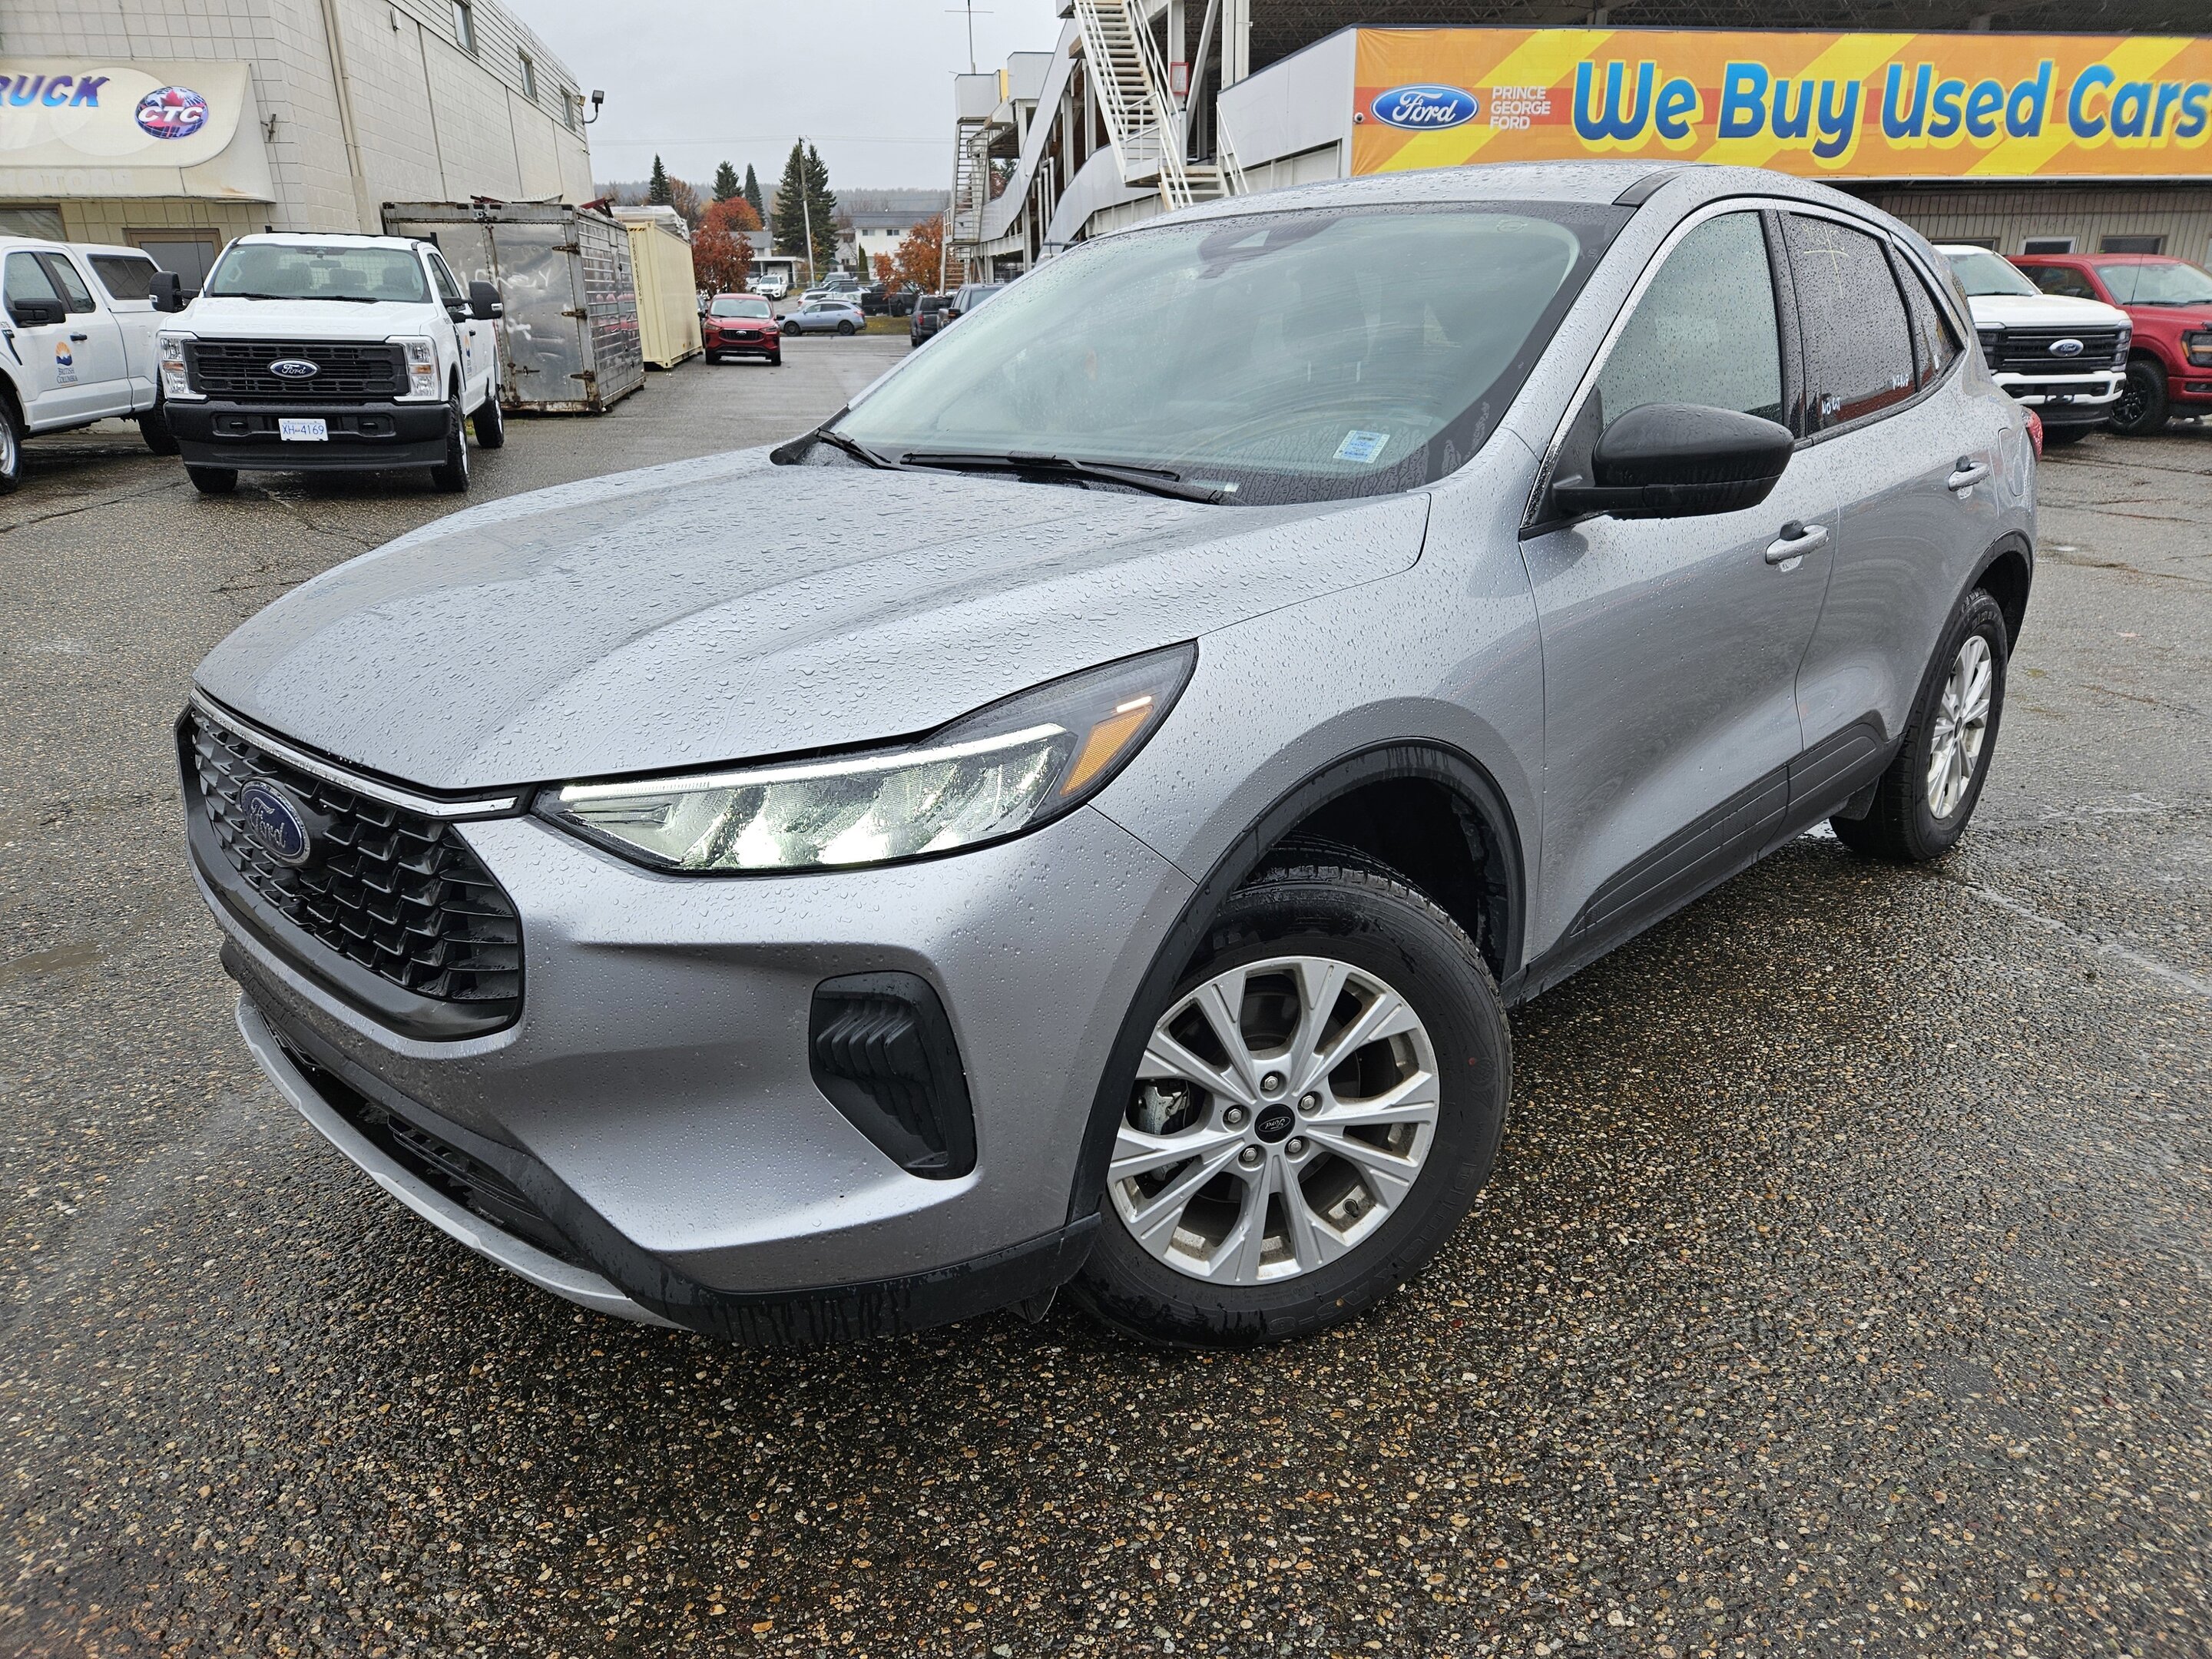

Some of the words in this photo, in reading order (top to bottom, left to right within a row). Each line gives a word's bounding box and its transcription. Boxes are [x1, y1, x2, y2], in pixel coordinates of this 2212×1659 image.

[1492, 85, 1547, 100] PRINCE
[137, 105, 204, 124] CTC
[1490, 101, 1552, 115] GEORGE
[1573, 61, 1697, 141] We
[1717, 61, 1861, 159] Buy
[1881, 59, 2055, 139] Used
[2068, 64, 2212, 139] Cars
[1488, 115, 1532, 131] FORD
[250, 796, 286, 849] Ford
[1264, 1118, 1286, 1130] Ford
